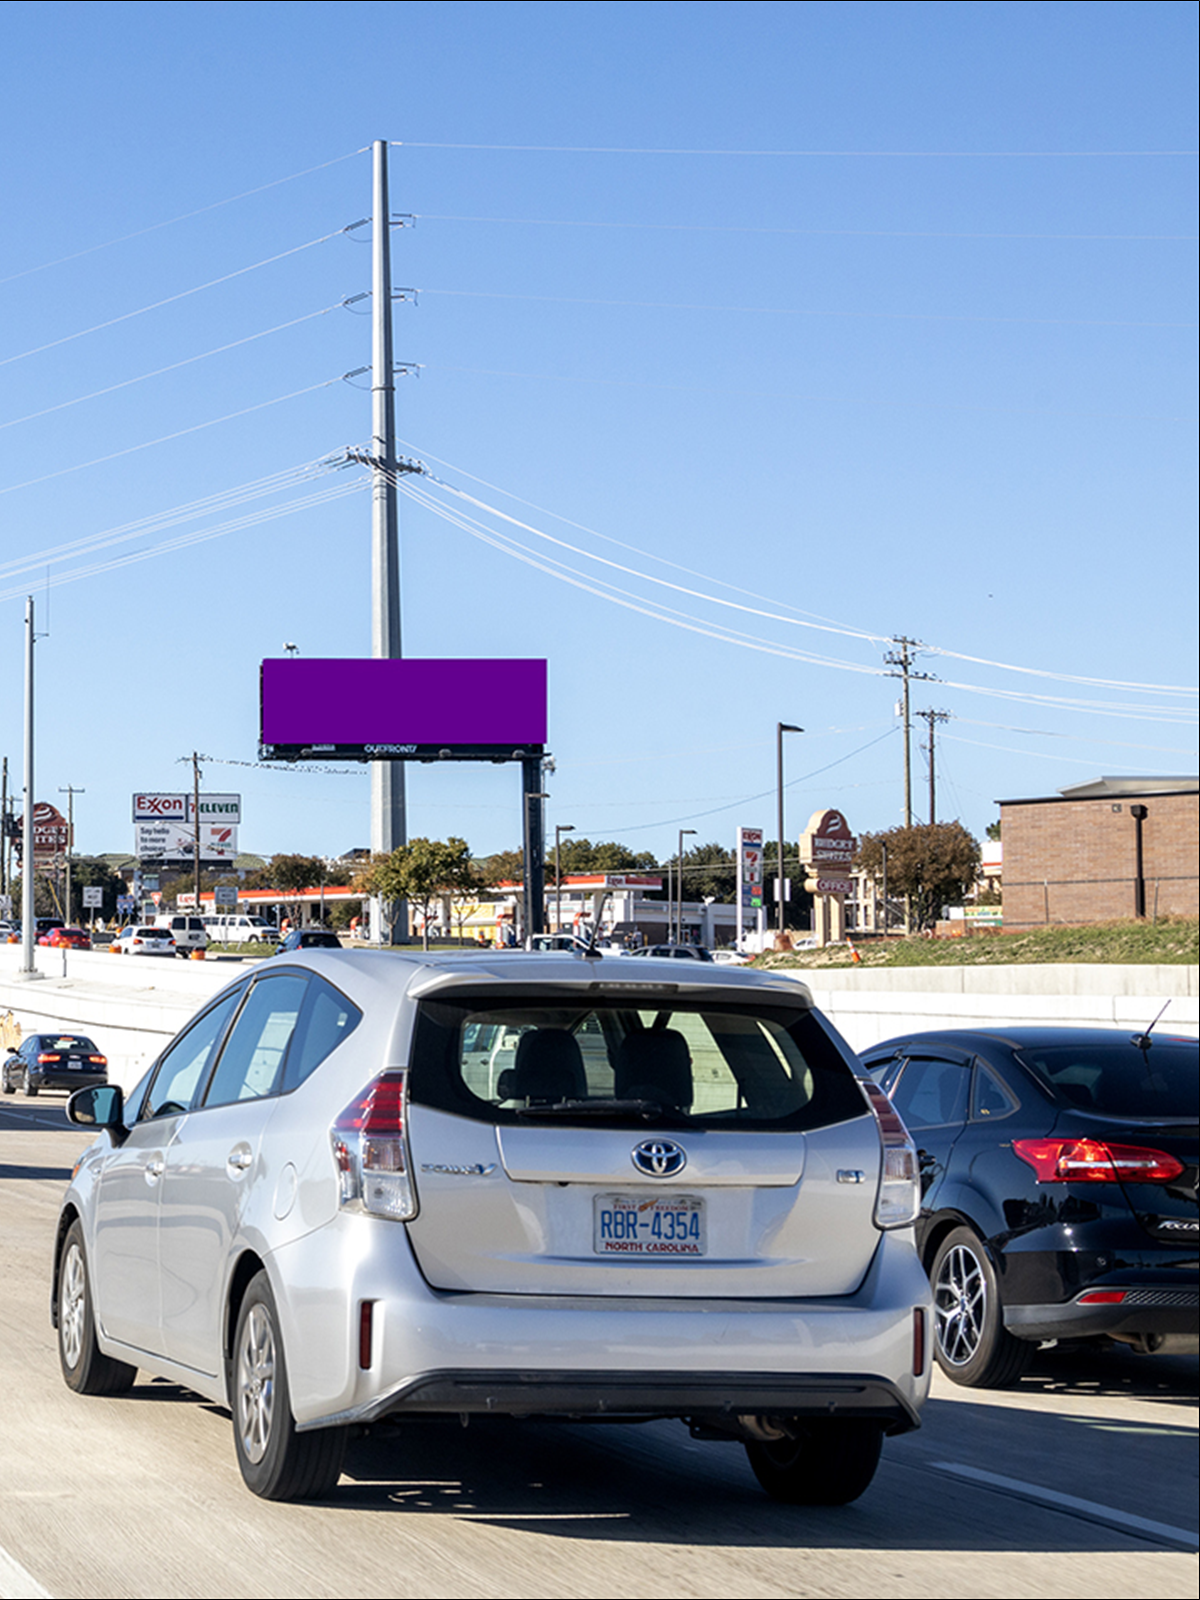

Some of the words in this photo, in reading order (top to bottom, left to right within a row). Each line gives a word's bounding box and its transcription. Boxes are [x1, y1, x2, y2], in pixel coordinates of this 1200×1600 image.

[137, 796, 183, 814] Exxon
[601, 1210, 700, 1240] RBR-4354
[605, 1242, 642, 1252] NORTH
[646, 1243, 699, 1253] CAROLINA
